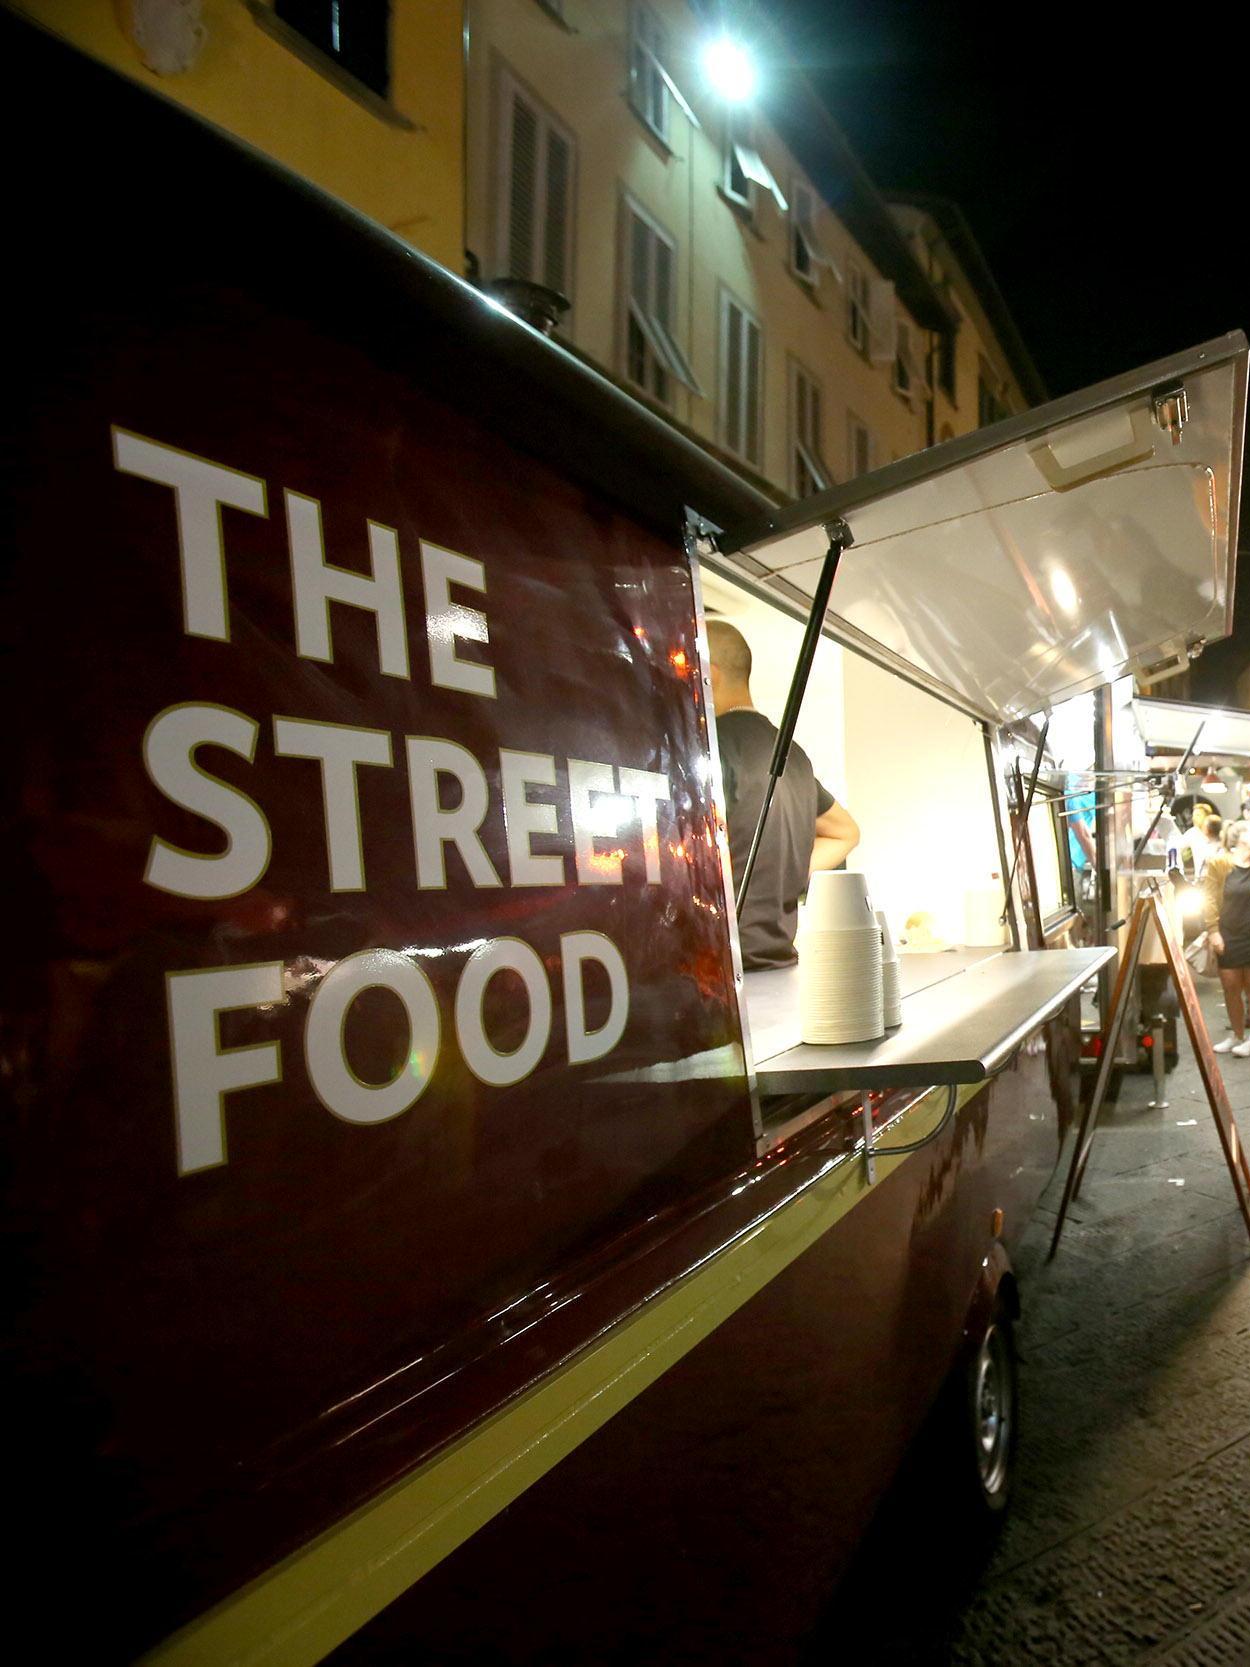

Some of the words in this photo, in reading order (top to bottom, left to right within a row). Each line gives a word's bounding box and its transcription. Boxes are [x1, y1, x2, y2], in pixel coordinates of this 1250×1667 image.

[111, 424, 498, 699] THE
[142, 702, 670, 900] STREET
[164, 930, 630, 1177] FOOD
